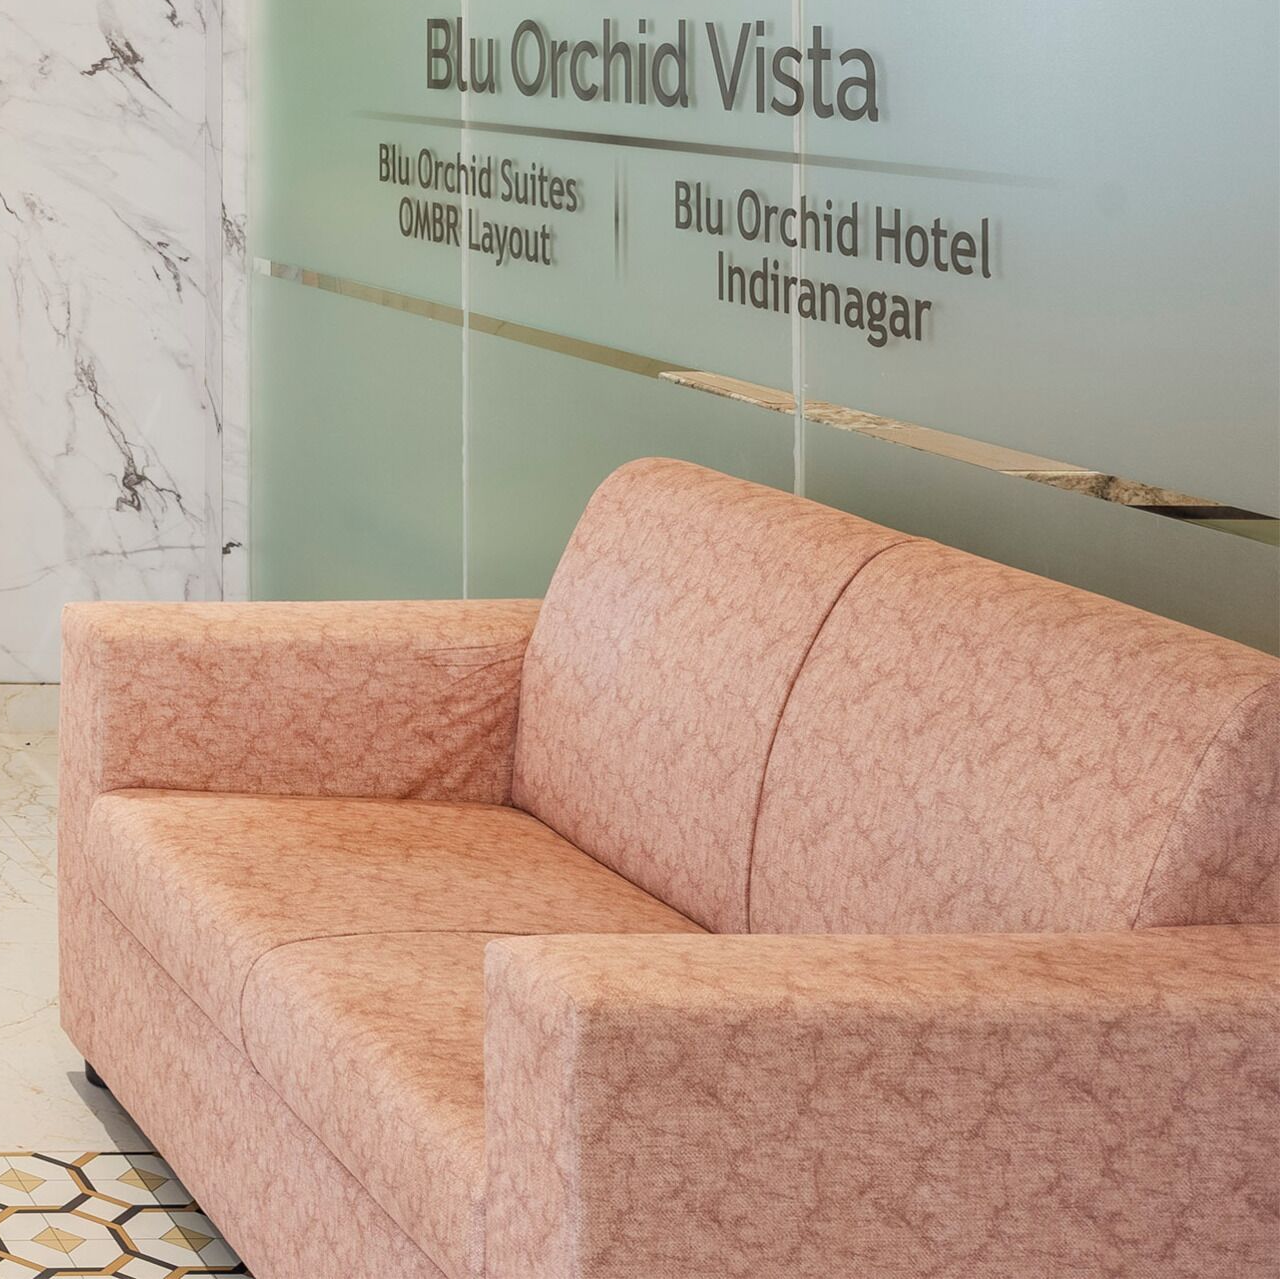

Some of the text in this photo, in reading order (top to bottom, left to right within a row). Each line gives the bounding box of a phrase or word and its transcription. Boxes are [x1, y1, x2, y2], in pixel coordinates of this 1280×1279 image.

[427, 17, 878, 122] Blu Orchid Vista
[379, 144, 577, 212] Blu Orchid Suites
[398, 197, 552, 266] OMBR Layout
[675, 181, 992, 278] Blu Orchid Hotel
[718, 251, 933, 347] Indiranagar
